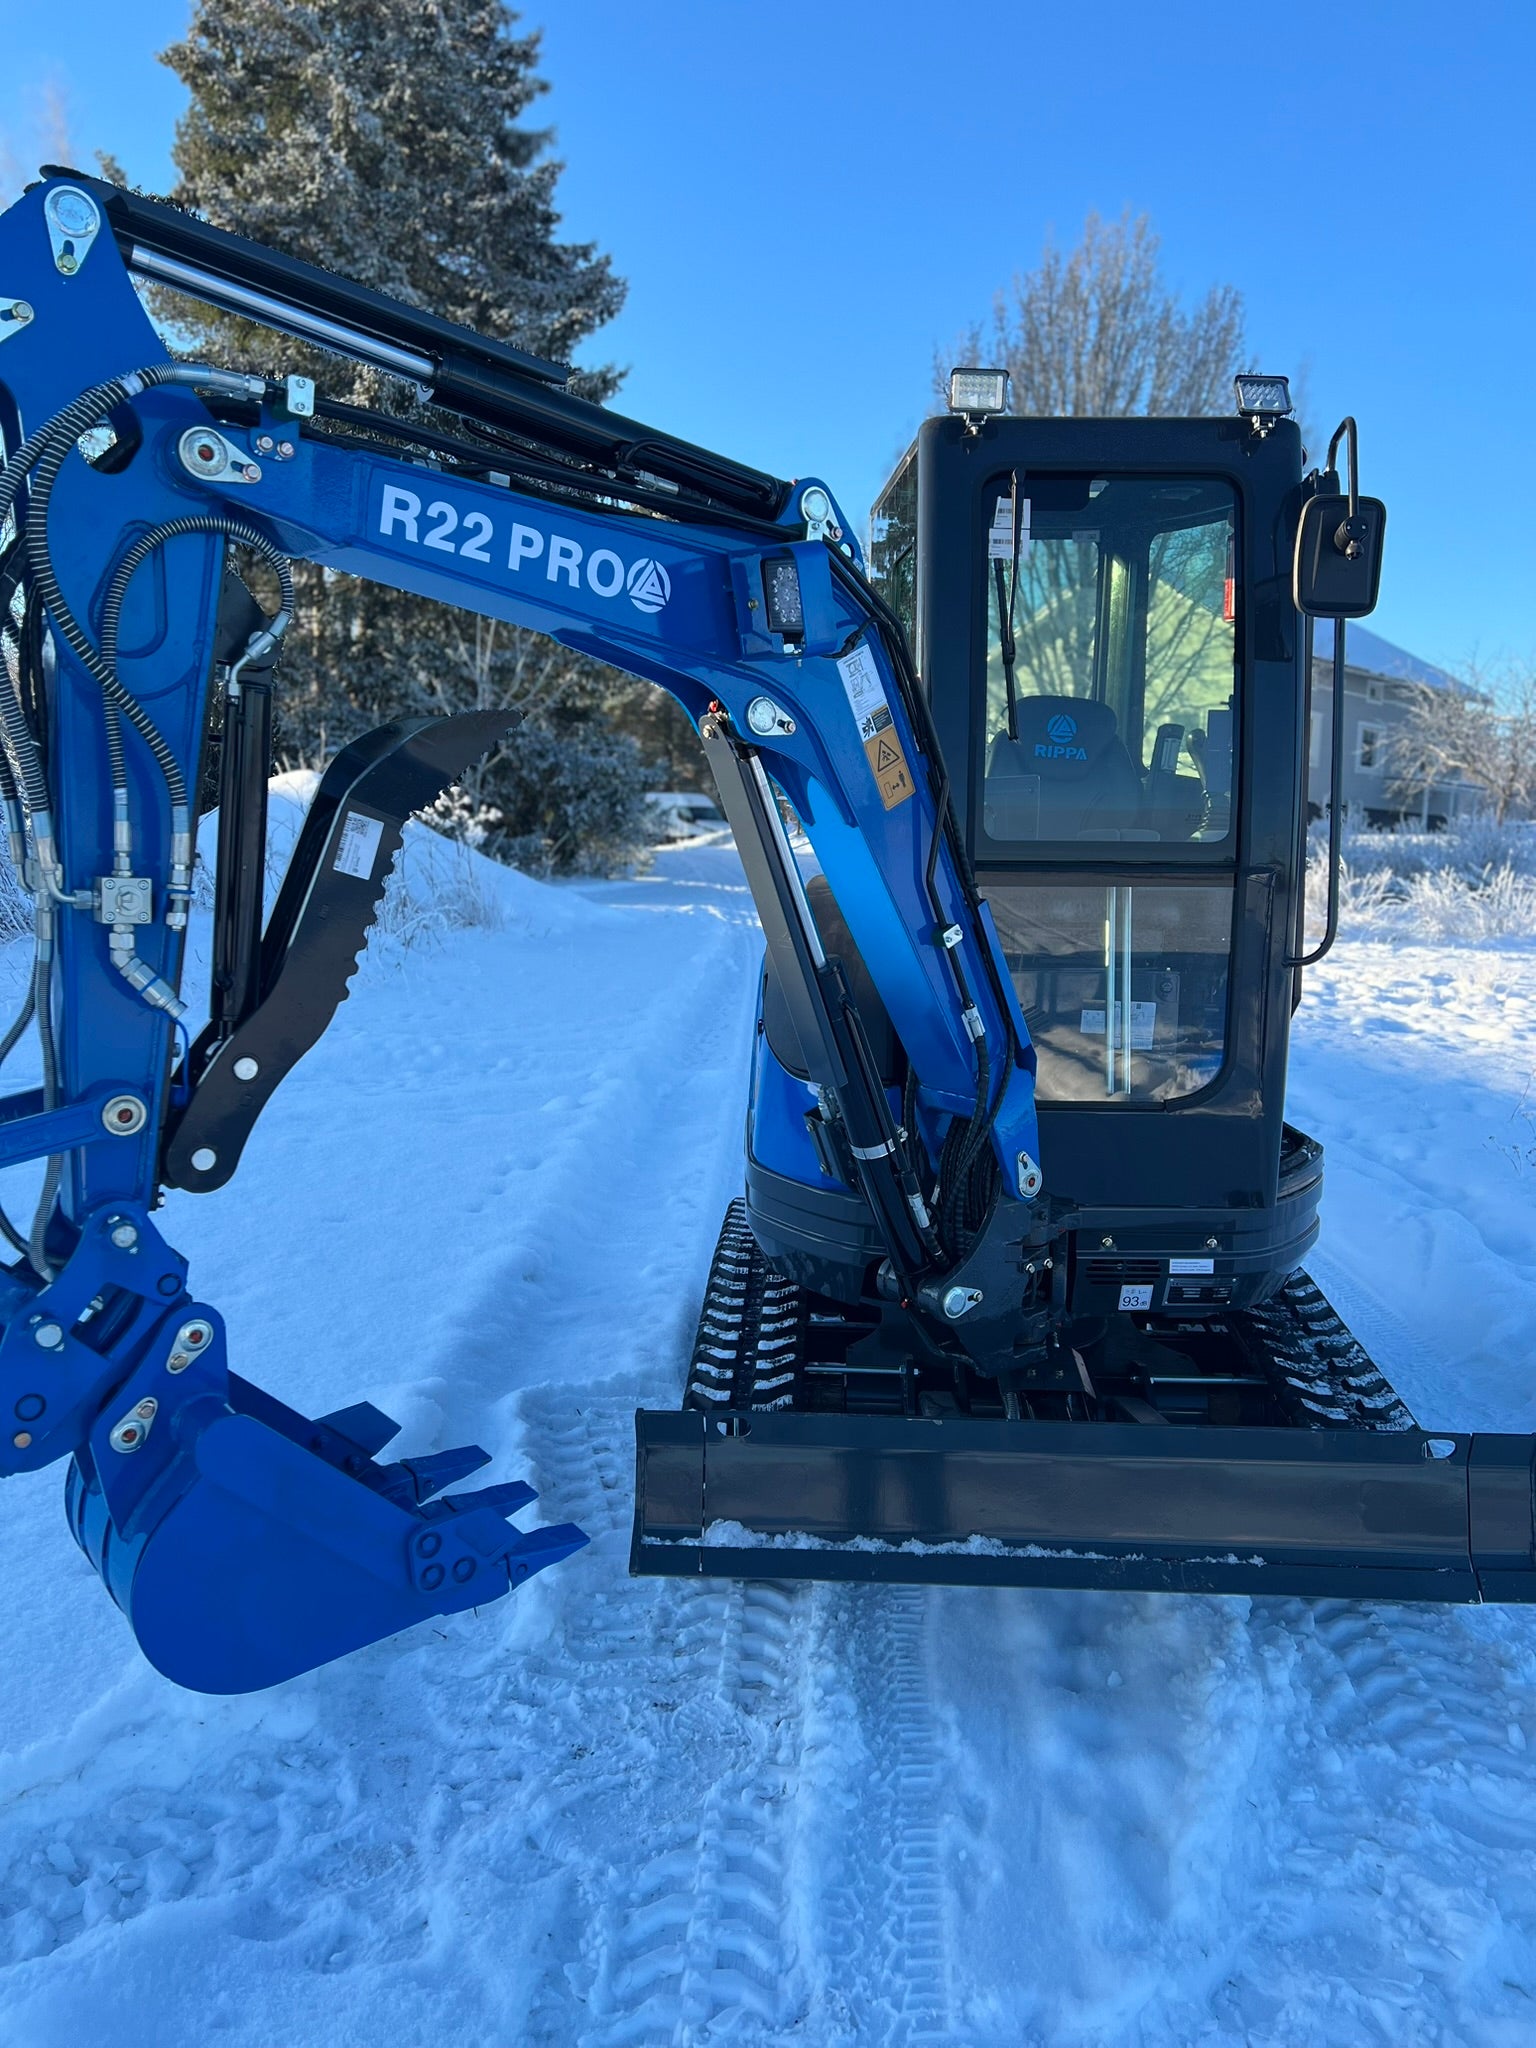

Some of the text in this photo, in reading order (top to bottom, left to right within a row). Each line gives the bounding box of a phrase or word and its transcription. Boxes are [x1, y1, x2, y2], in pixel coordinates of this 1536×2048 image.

[379, 484, 625, 598] R22 PRO
[1034, 744, 1088, 760] RIPPA
[1122, 1296, 1139, 1307] 93
